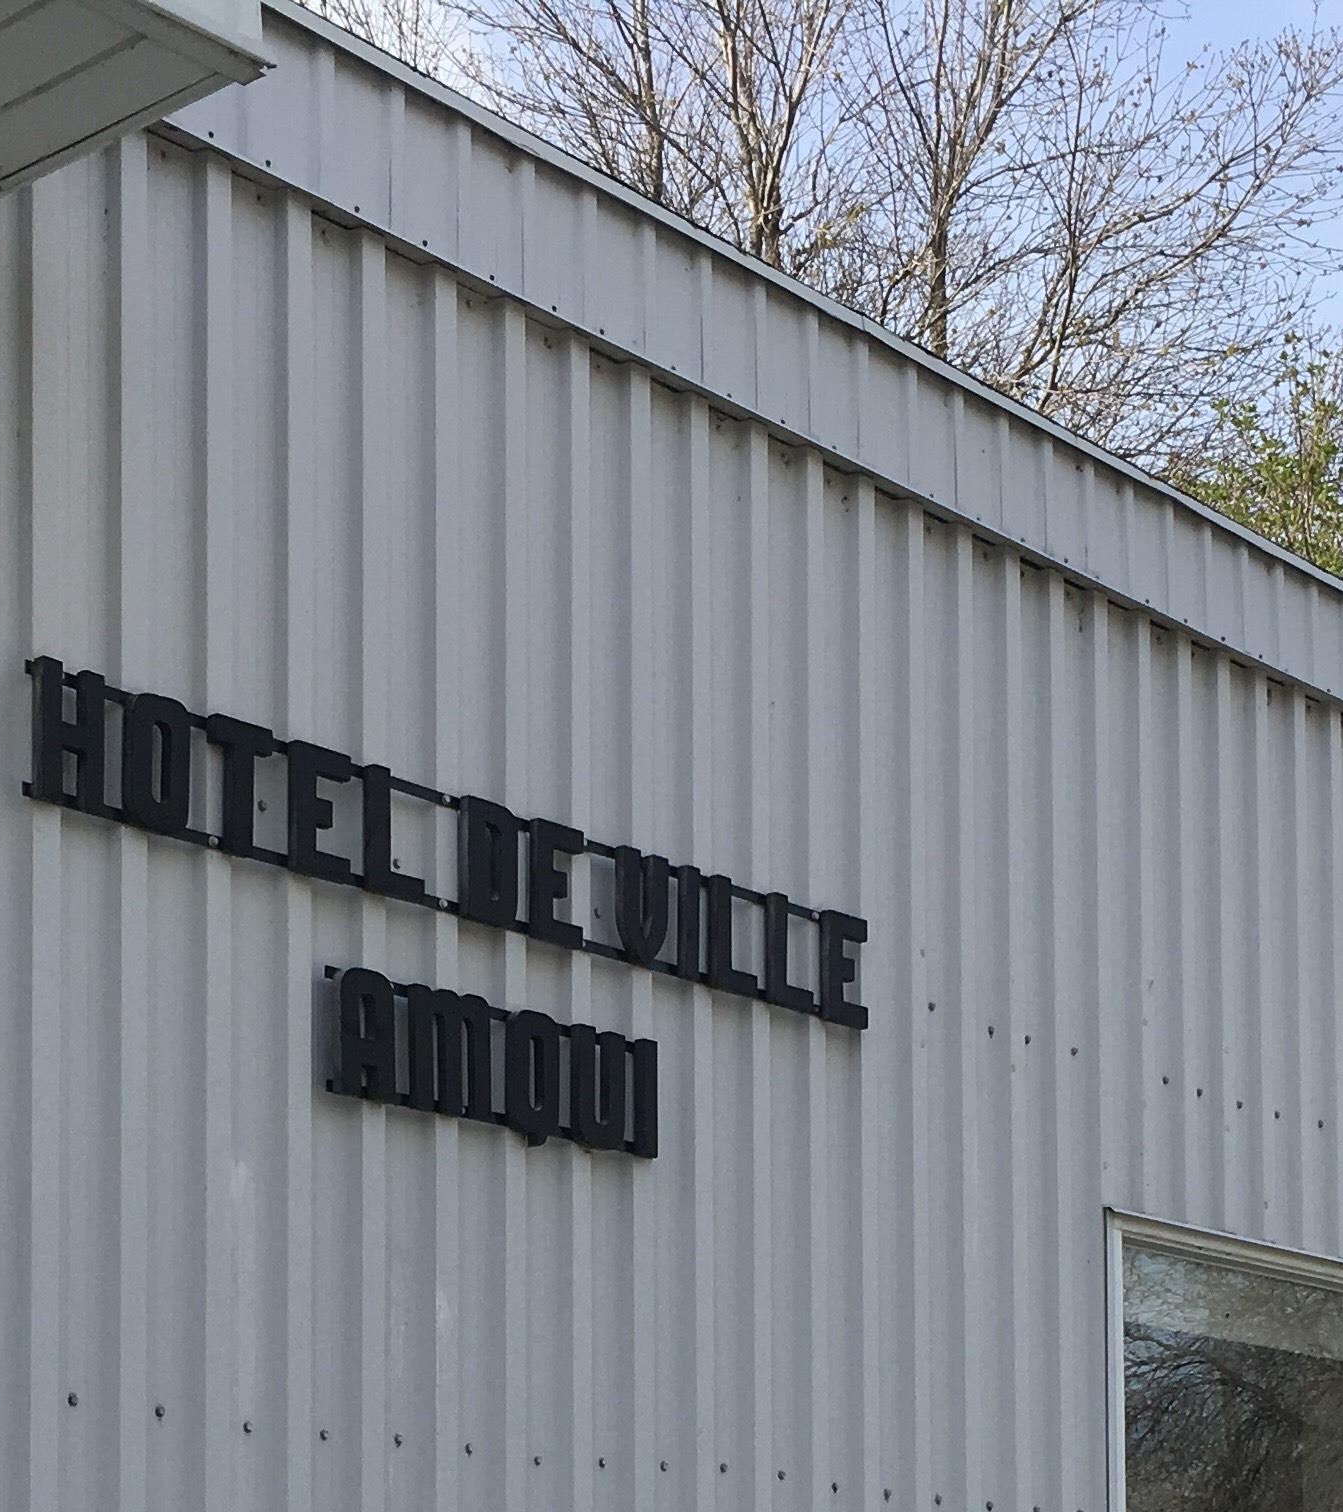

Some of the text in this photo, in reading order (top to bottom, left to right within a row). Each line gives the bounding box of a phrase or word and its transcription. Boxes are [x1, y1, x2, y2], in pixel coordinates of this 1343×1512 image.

[31, 655, 868, 1030] HOTEL DE VILLE
[338, 967, 657, 1158] AMQUI
